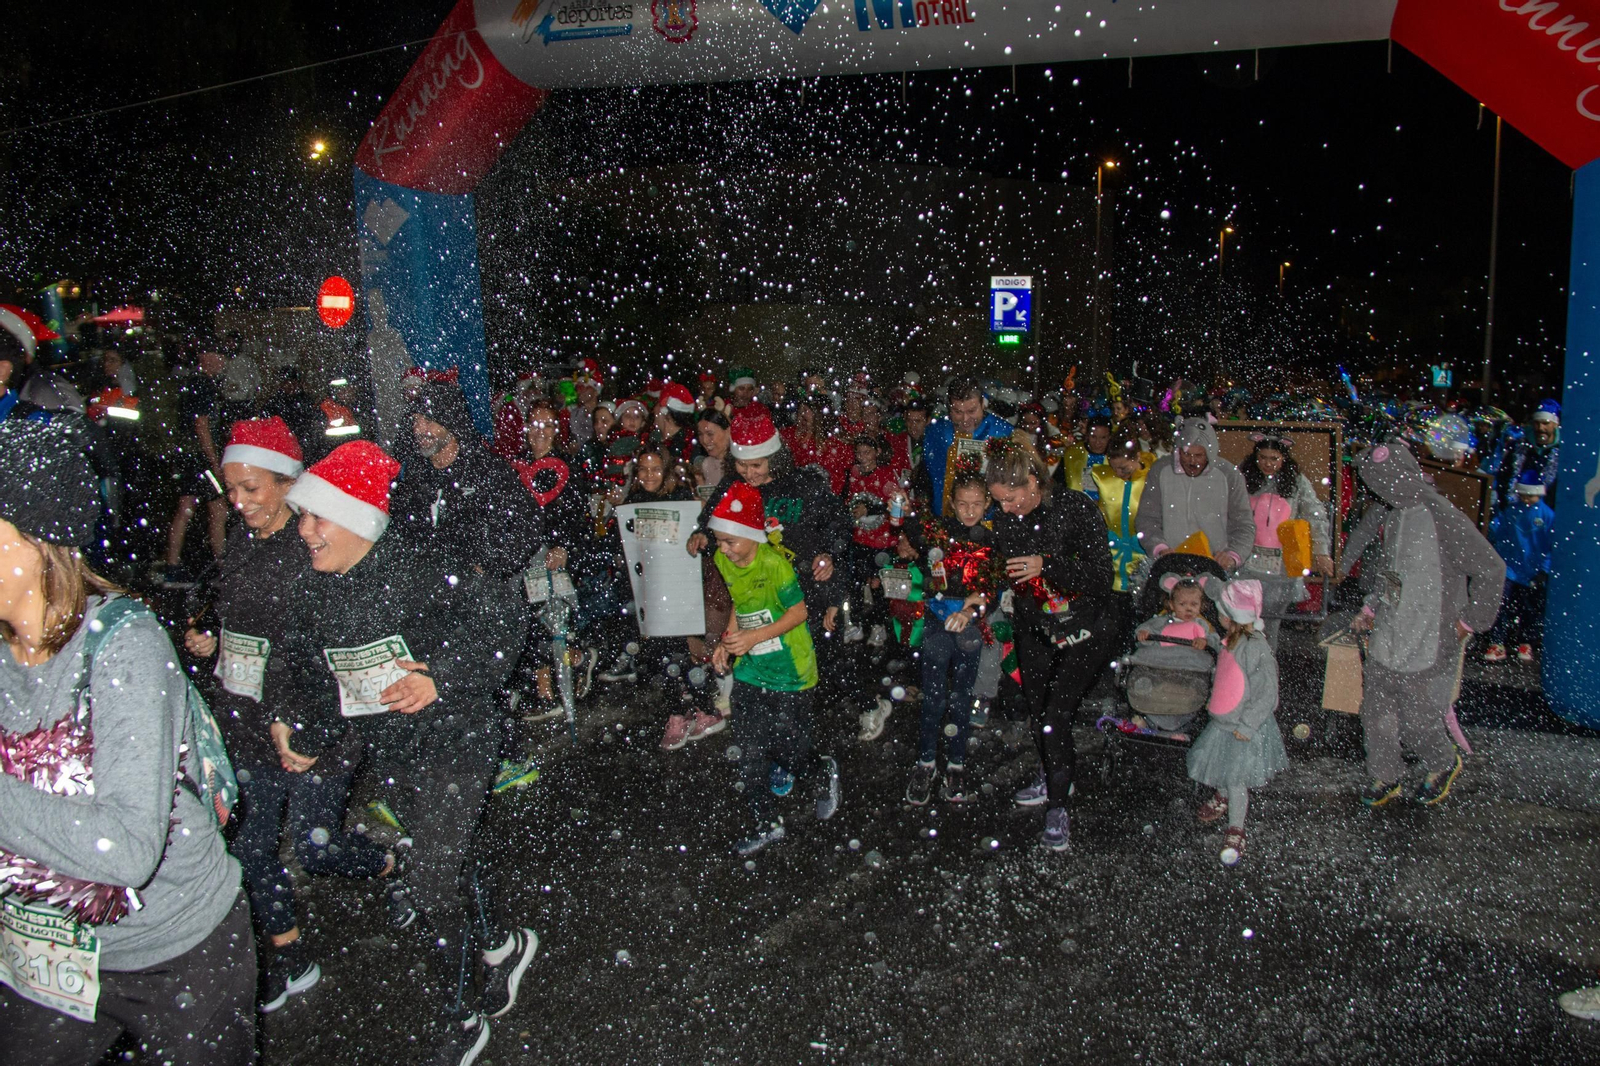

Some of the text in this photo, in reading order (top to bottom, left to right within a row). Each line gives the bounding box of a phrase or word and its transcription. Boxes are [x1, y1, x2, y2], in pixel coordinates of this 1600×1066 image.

[557, 4, 633, 27] deportes
[368, 32, 484, 166] Running
[994, 291, 1018, 320] P
[999, 335, 1019, 344] LIBRE
[1055, 628, 1091, 649] FILA
[16, 920, 29, 932] DE
[30, 926, 69, 941] MOTRIL
[0, 943, 85, 994] 216
